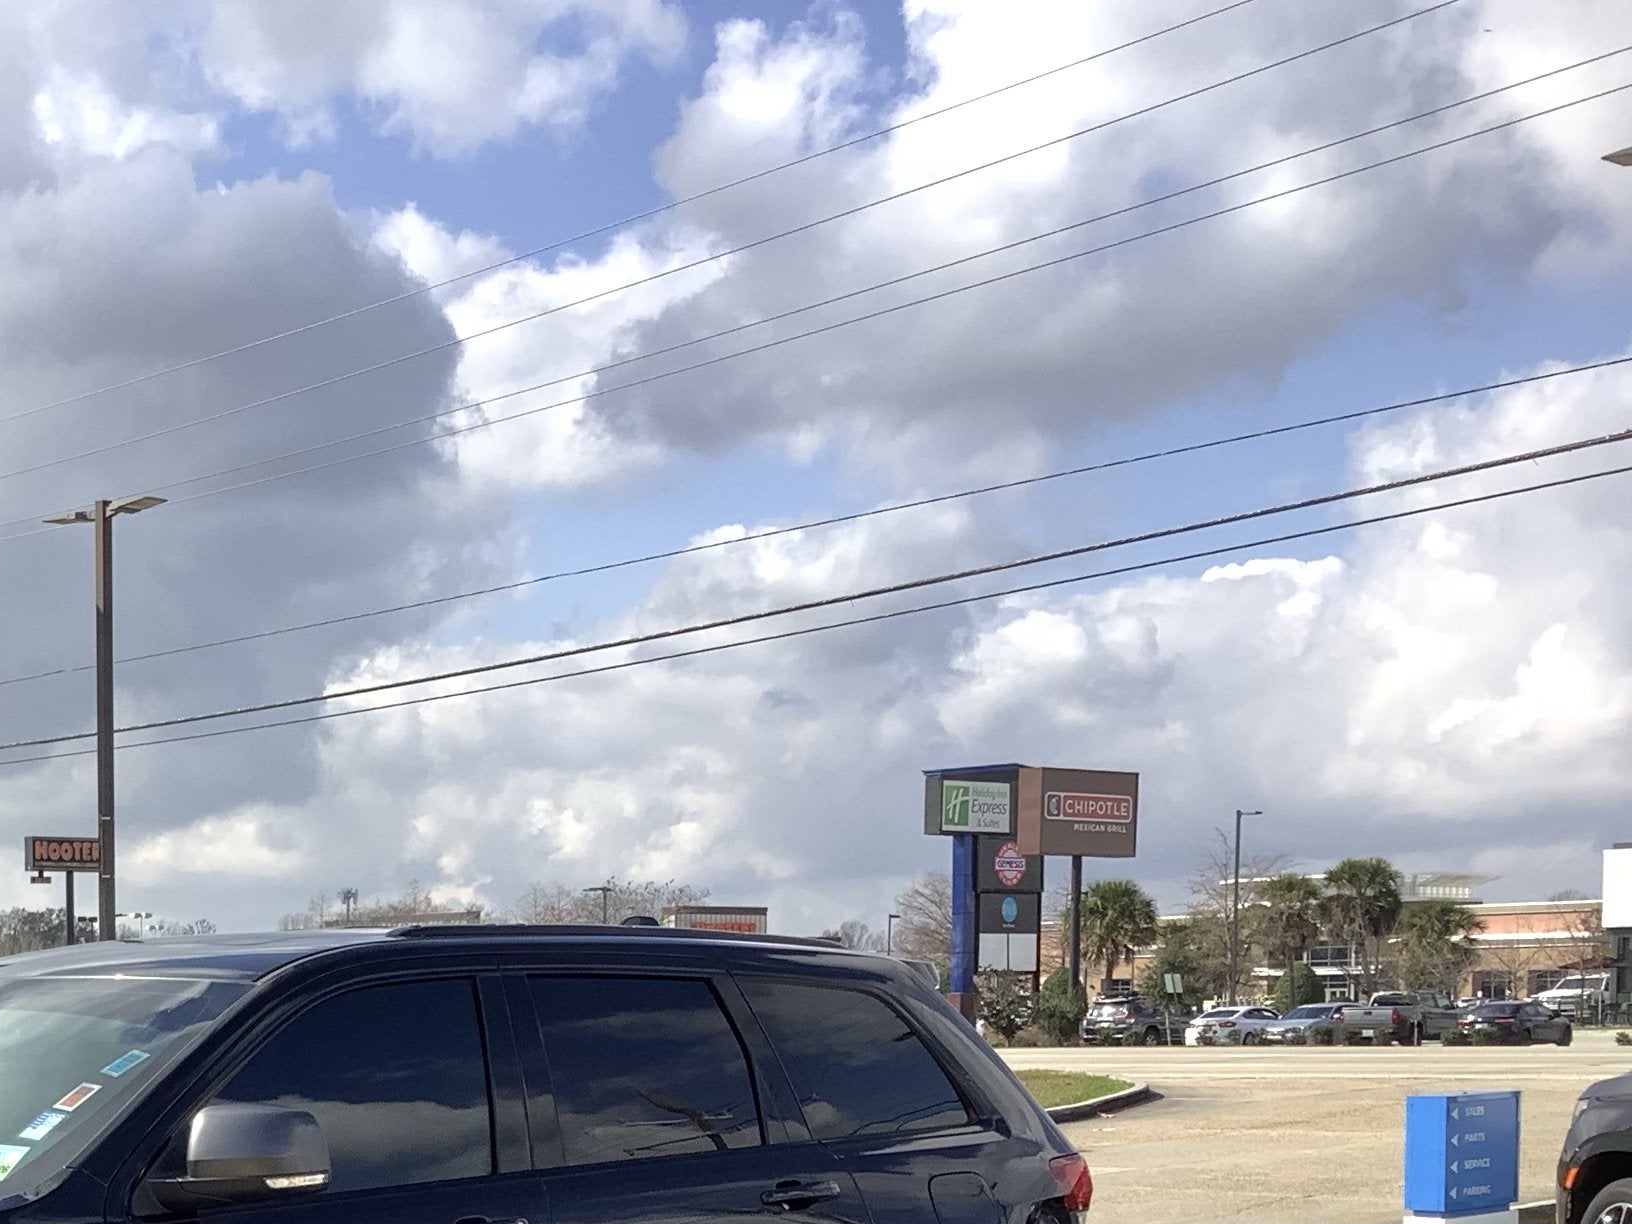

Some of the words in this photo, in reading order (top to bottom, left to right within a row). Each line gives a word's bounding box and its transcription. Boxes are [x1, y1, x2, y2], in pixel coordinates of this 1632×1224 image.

[971, 799, 1007, 817] Express
[1065, 800, 1128, 816] CHIPOTLE
[1073, 824, 1105, 832] MEXICAN
[1106, 825, 1127, 833] GRILL
[34, 840, 99, 861] HOOTER
[996, 860, 1024, 869] GENESIS
